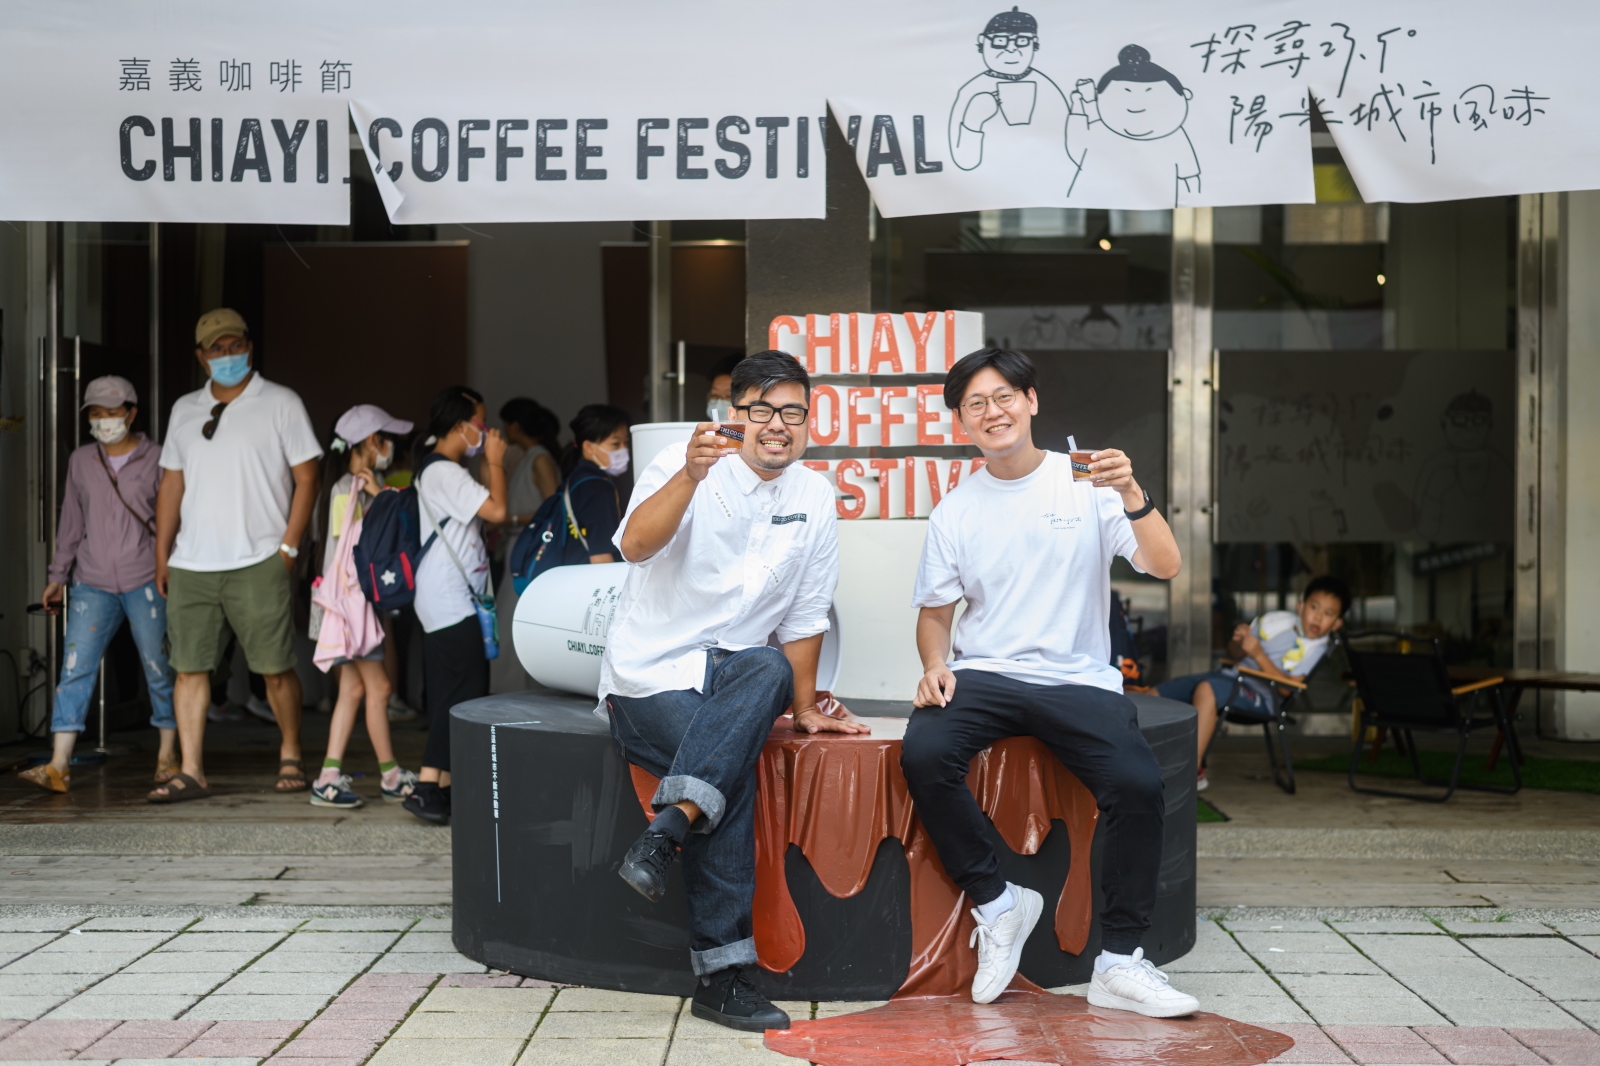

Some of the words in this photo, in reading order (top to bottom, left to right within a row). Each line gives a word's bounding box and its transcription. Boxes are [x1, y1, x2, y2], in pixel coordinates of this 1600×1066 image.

[119, 57, 352, 93] 嘉義咖啡節
[809, 384, 973, 447] OFFE
